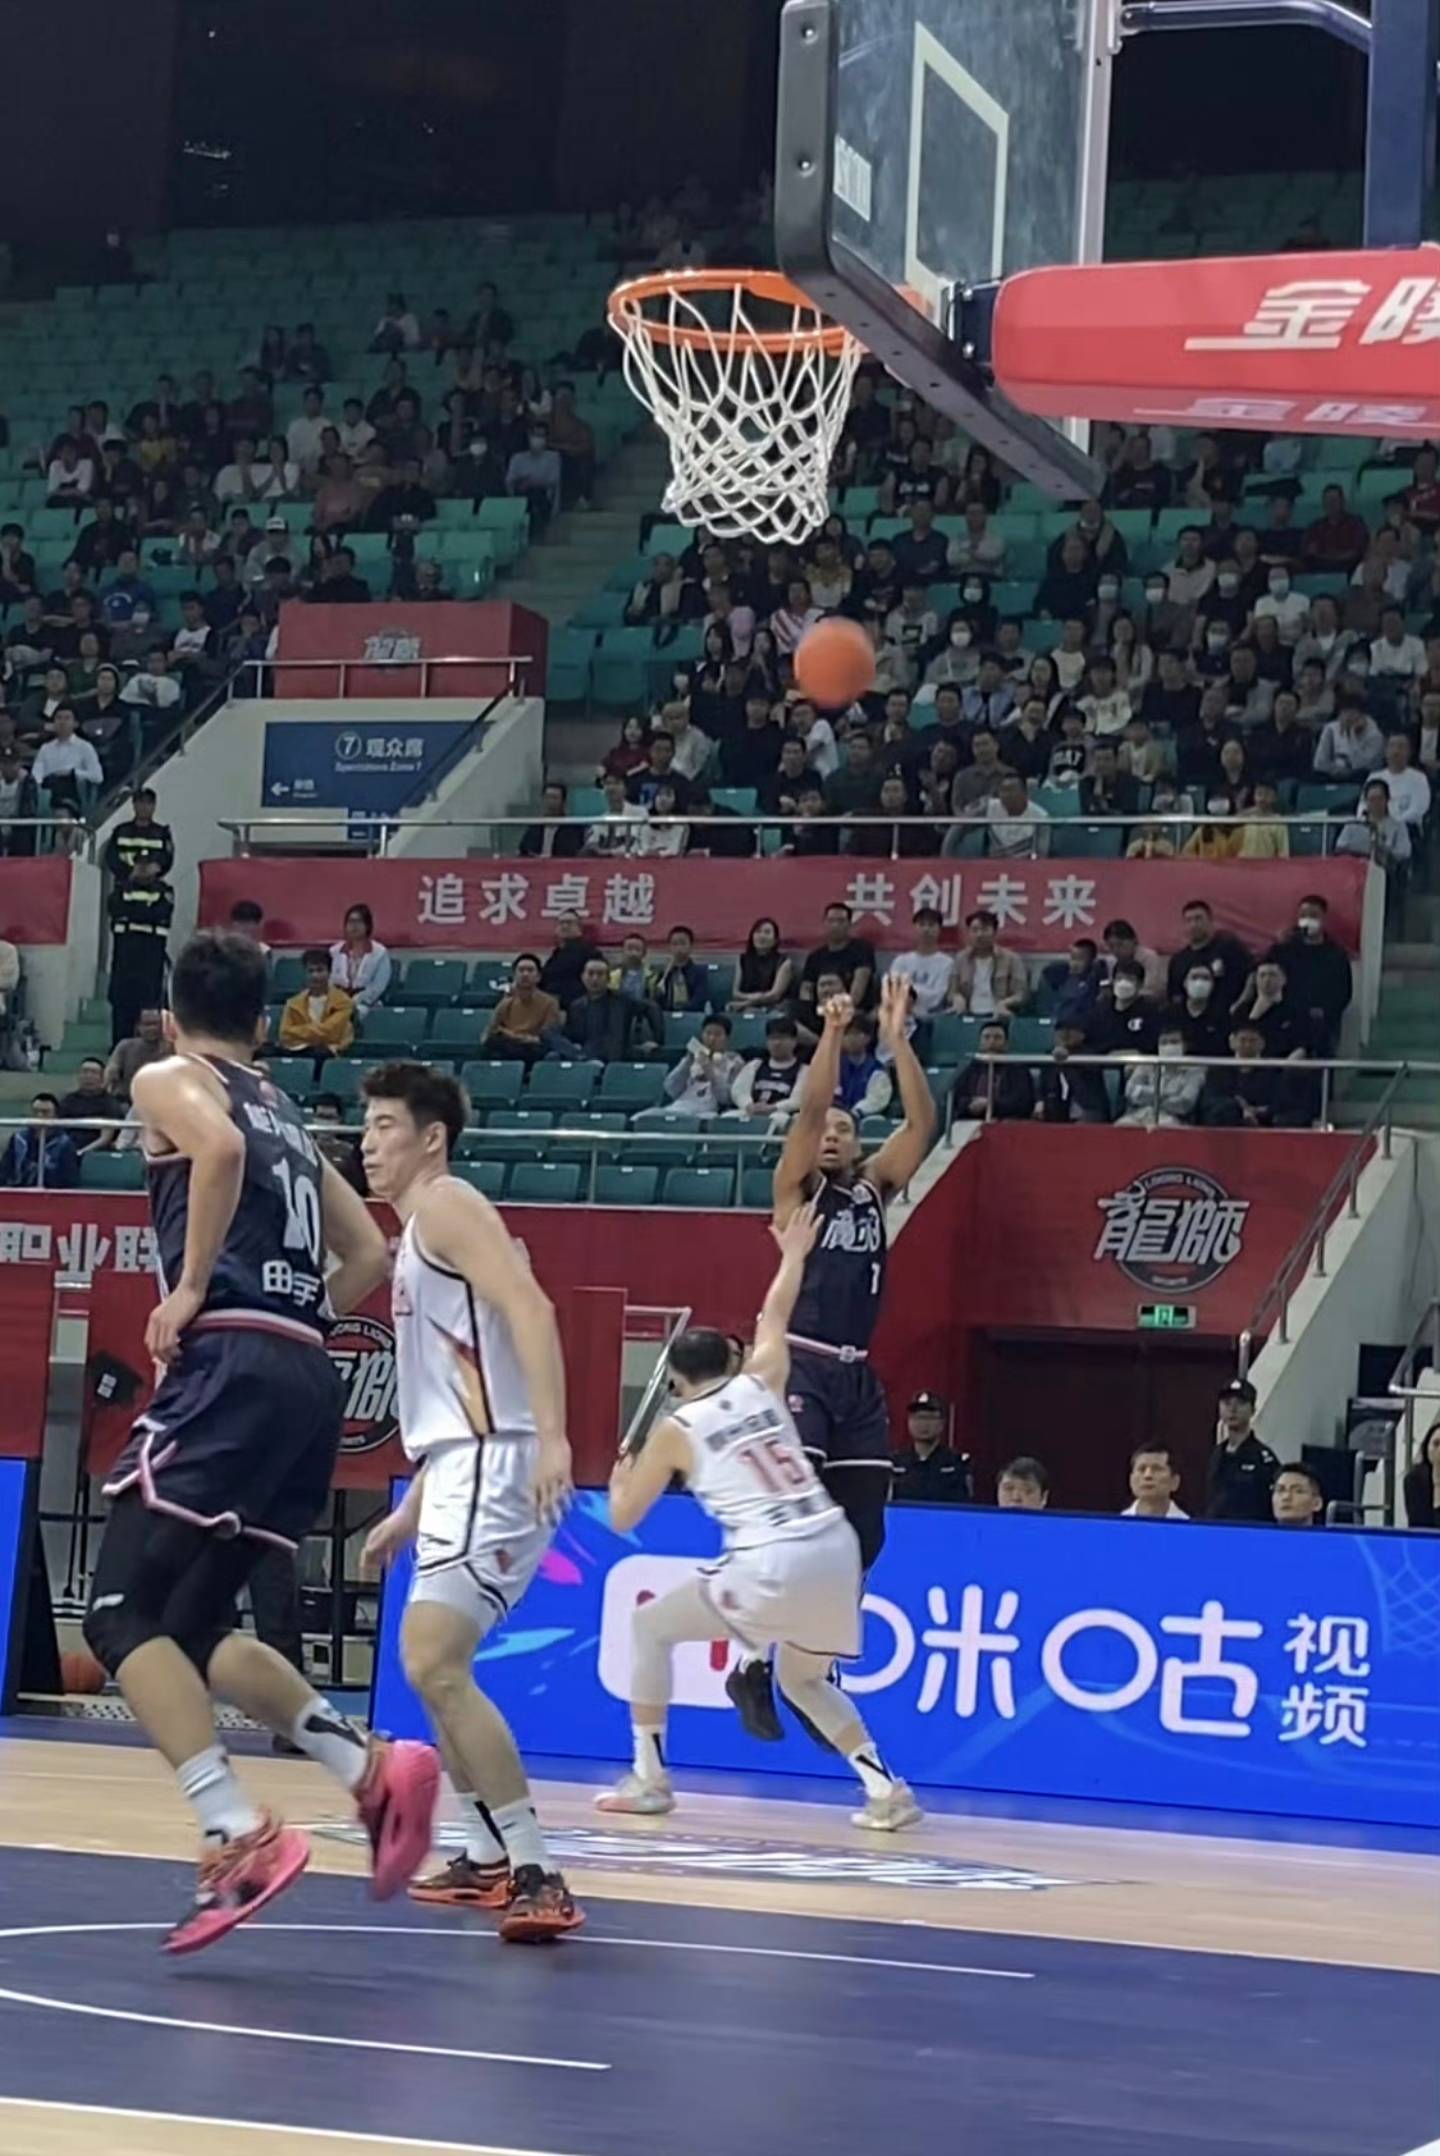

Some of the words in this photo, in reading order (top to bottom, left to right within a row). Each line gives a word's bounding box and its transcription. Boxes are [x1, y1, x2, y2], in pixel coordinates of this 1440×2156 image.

[366, 737, 424, 758] 观众席
[417, 873, 655, 925] 追求卓越
[845, 873, 1097, 929] 共创未来
[272, 1157, 321, 1266] 10
[870, 1262, 880, 1294] 1
[1279, 1613, 1371, 1748] 视频
